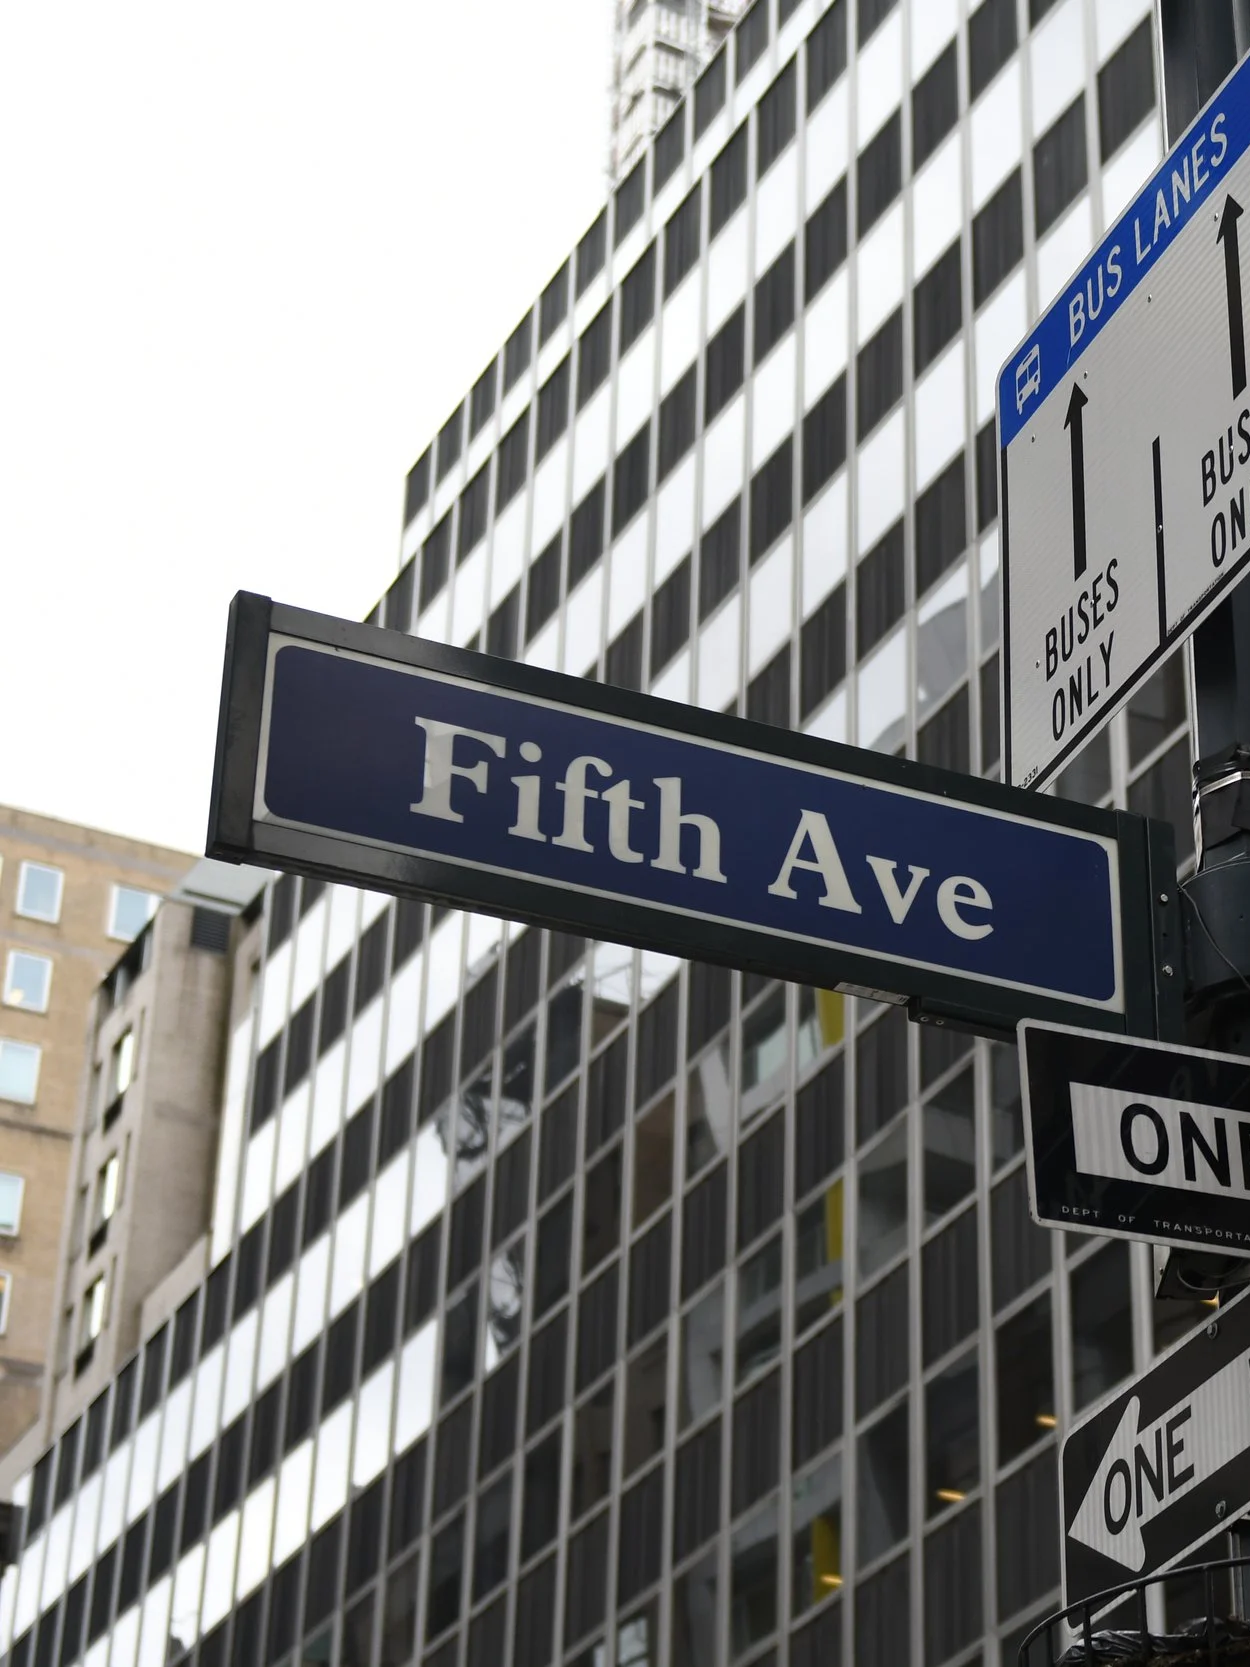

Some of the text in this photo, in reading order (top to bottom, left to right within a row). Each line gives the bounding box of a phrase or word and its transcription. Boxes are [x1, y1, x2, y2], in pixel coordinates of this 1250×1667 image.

[1068, 113, 1228, 348] BUS LANES
[1045, 558, 1119, 682] BUSES
[1052, 631, 1115, 740] ONLY
[409, 716, 995, 941] Fifth Ave
[1061, 1205, 1100, 1218] DEPT
[1118, 1214, 1136, 1224] OF
[1104, 1405, 1195, 1535] ONE
